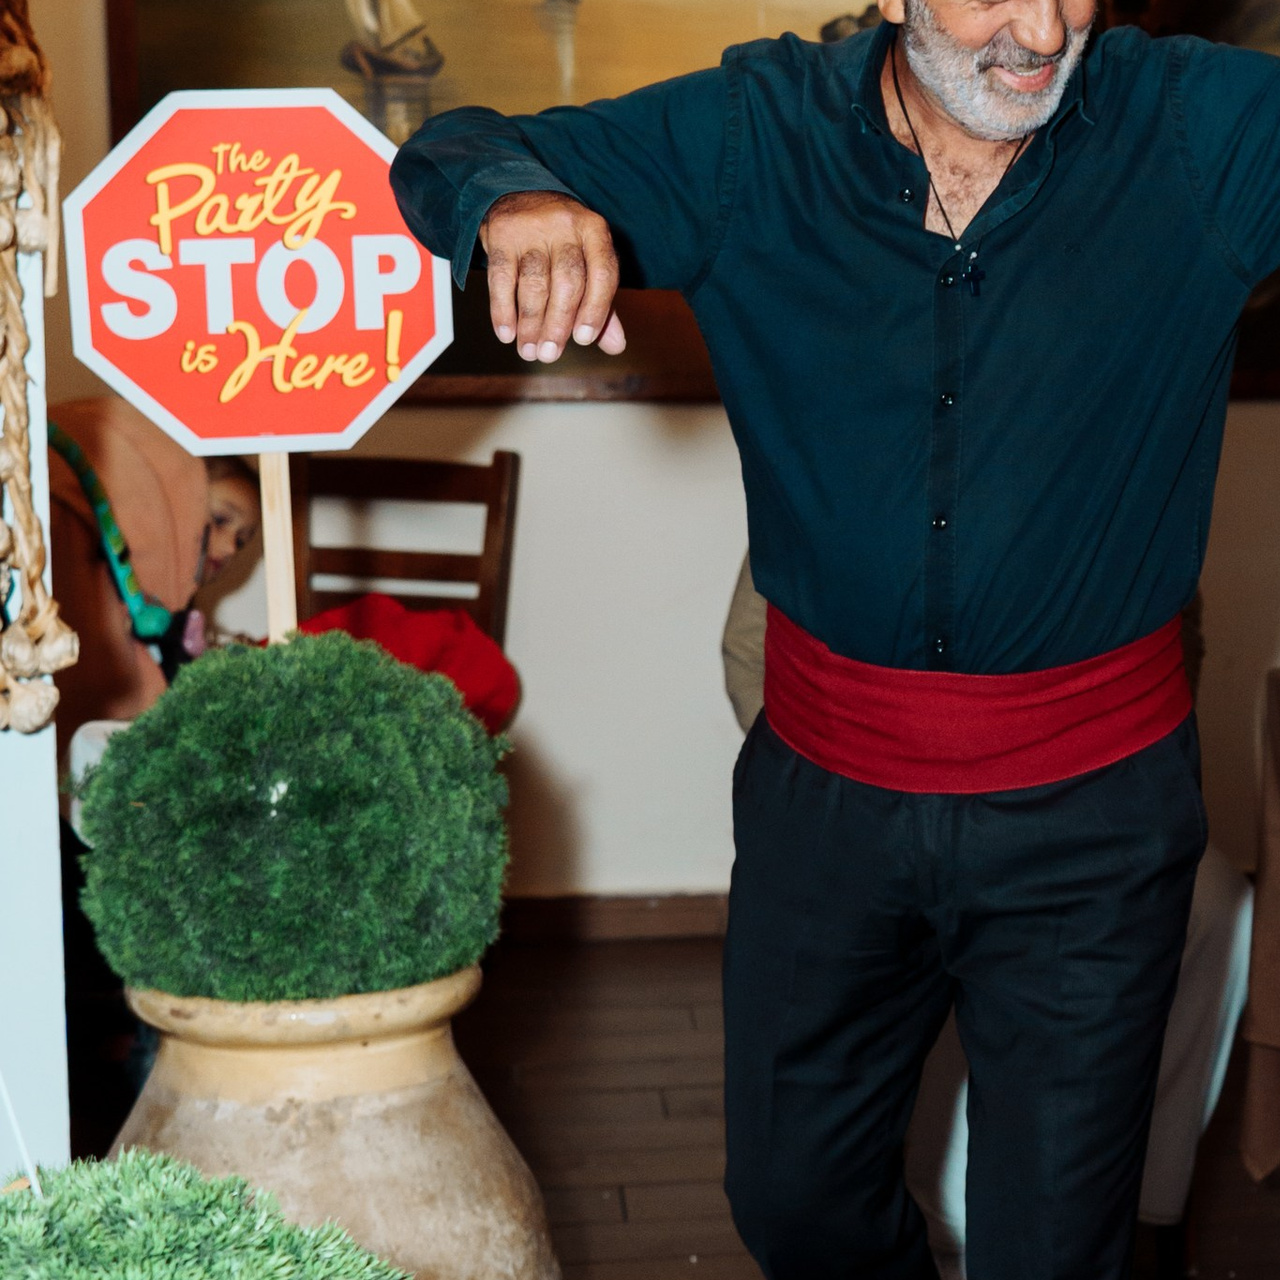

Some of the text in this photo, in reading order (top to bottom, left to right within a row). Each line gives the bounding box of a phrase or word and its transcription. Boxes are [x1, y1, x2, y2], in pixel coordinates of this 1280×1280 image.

[145, 152, 357, 256] Party
[211, 141, 271, 176] The
[100, 233, 423, 341] STOP
[180, 307, 404, 404] is Here!
